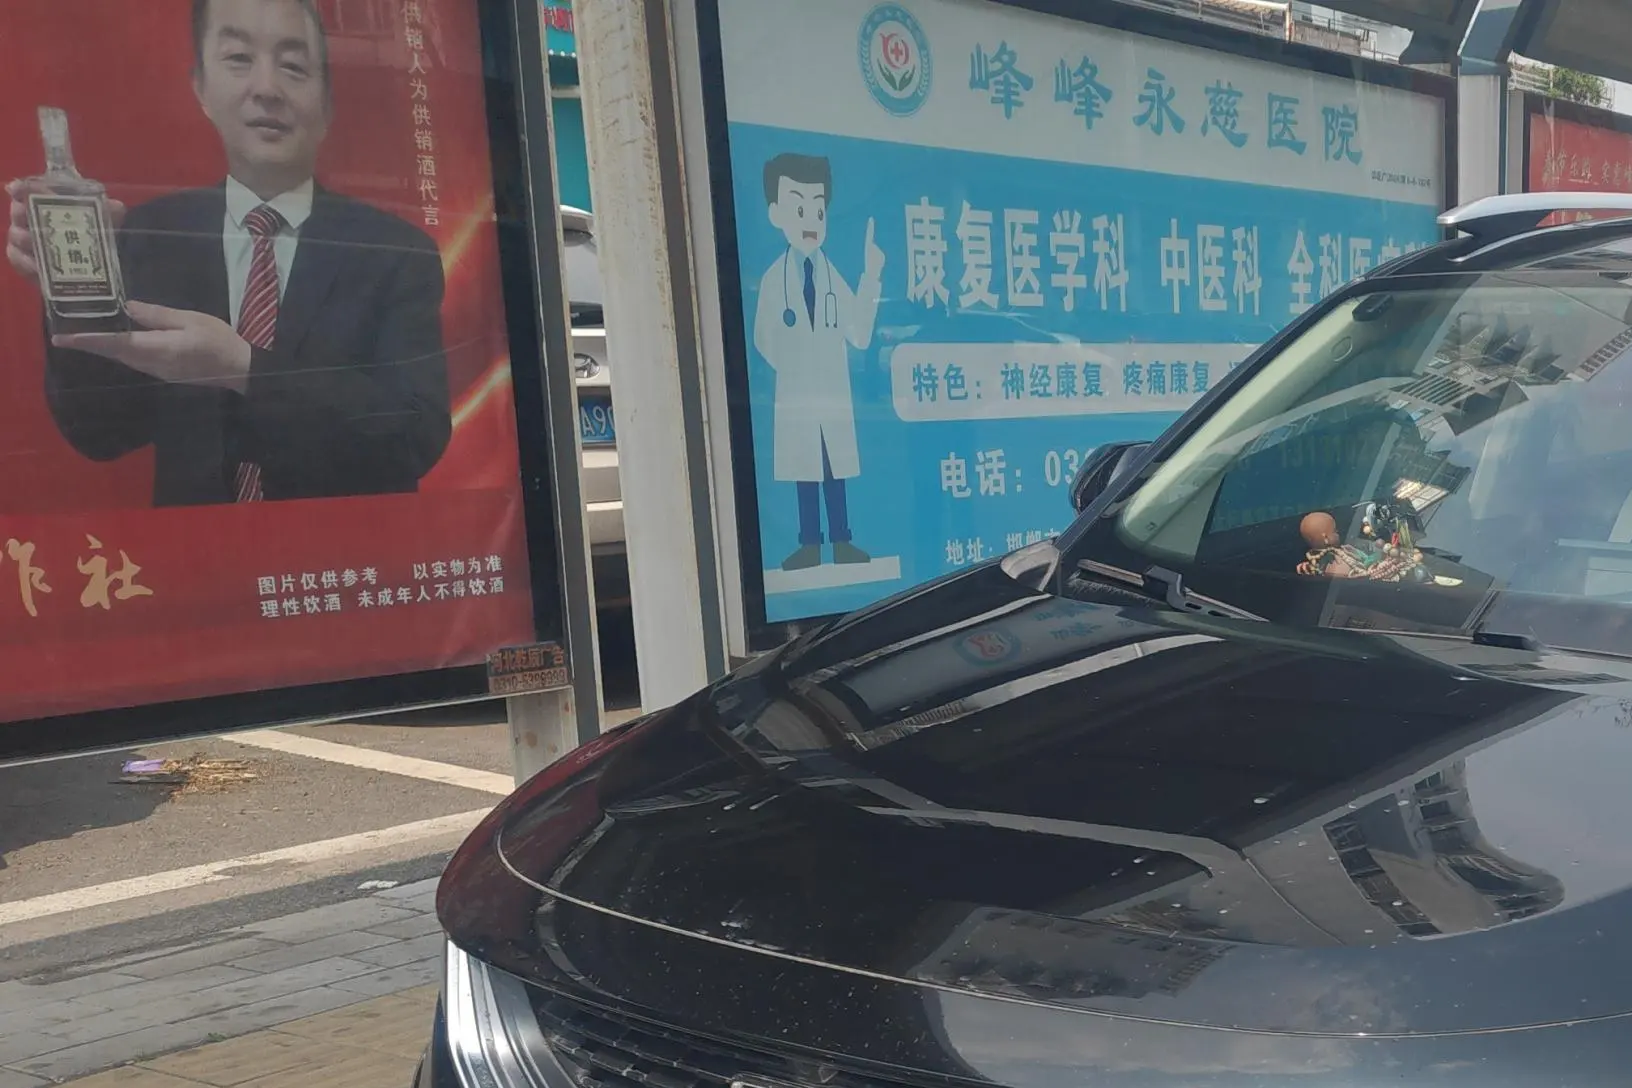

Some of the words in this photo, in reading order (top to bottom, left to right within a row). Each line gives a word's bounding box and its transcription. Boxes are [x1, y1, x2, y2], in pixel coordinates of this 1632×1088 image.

[402, 0, 439, 226] 供销人为供销酒代言
[969, 40, 1362, 165] 峰峰永慈医院
[904, 196, 1129, 313] 康复医学科
[1160, 218, 1262, 315] 中医科
[912, 363, 982, 402] 特色：
[1000, 362, 1104, 400] 神经康复
[1123, 360, 1210, 395] 疼痛康复
[941, 449, 1022, 498] 电话：
[1045, 448, 1098, 486] 03
[257, 567, 378, 596] 图片仅供参考
[413, 555, 502, 581] 以实物为准
[260, 593, 342, 618] 理性饮酒
[358, 576, 504, 608] 未成年人不得饮酒
